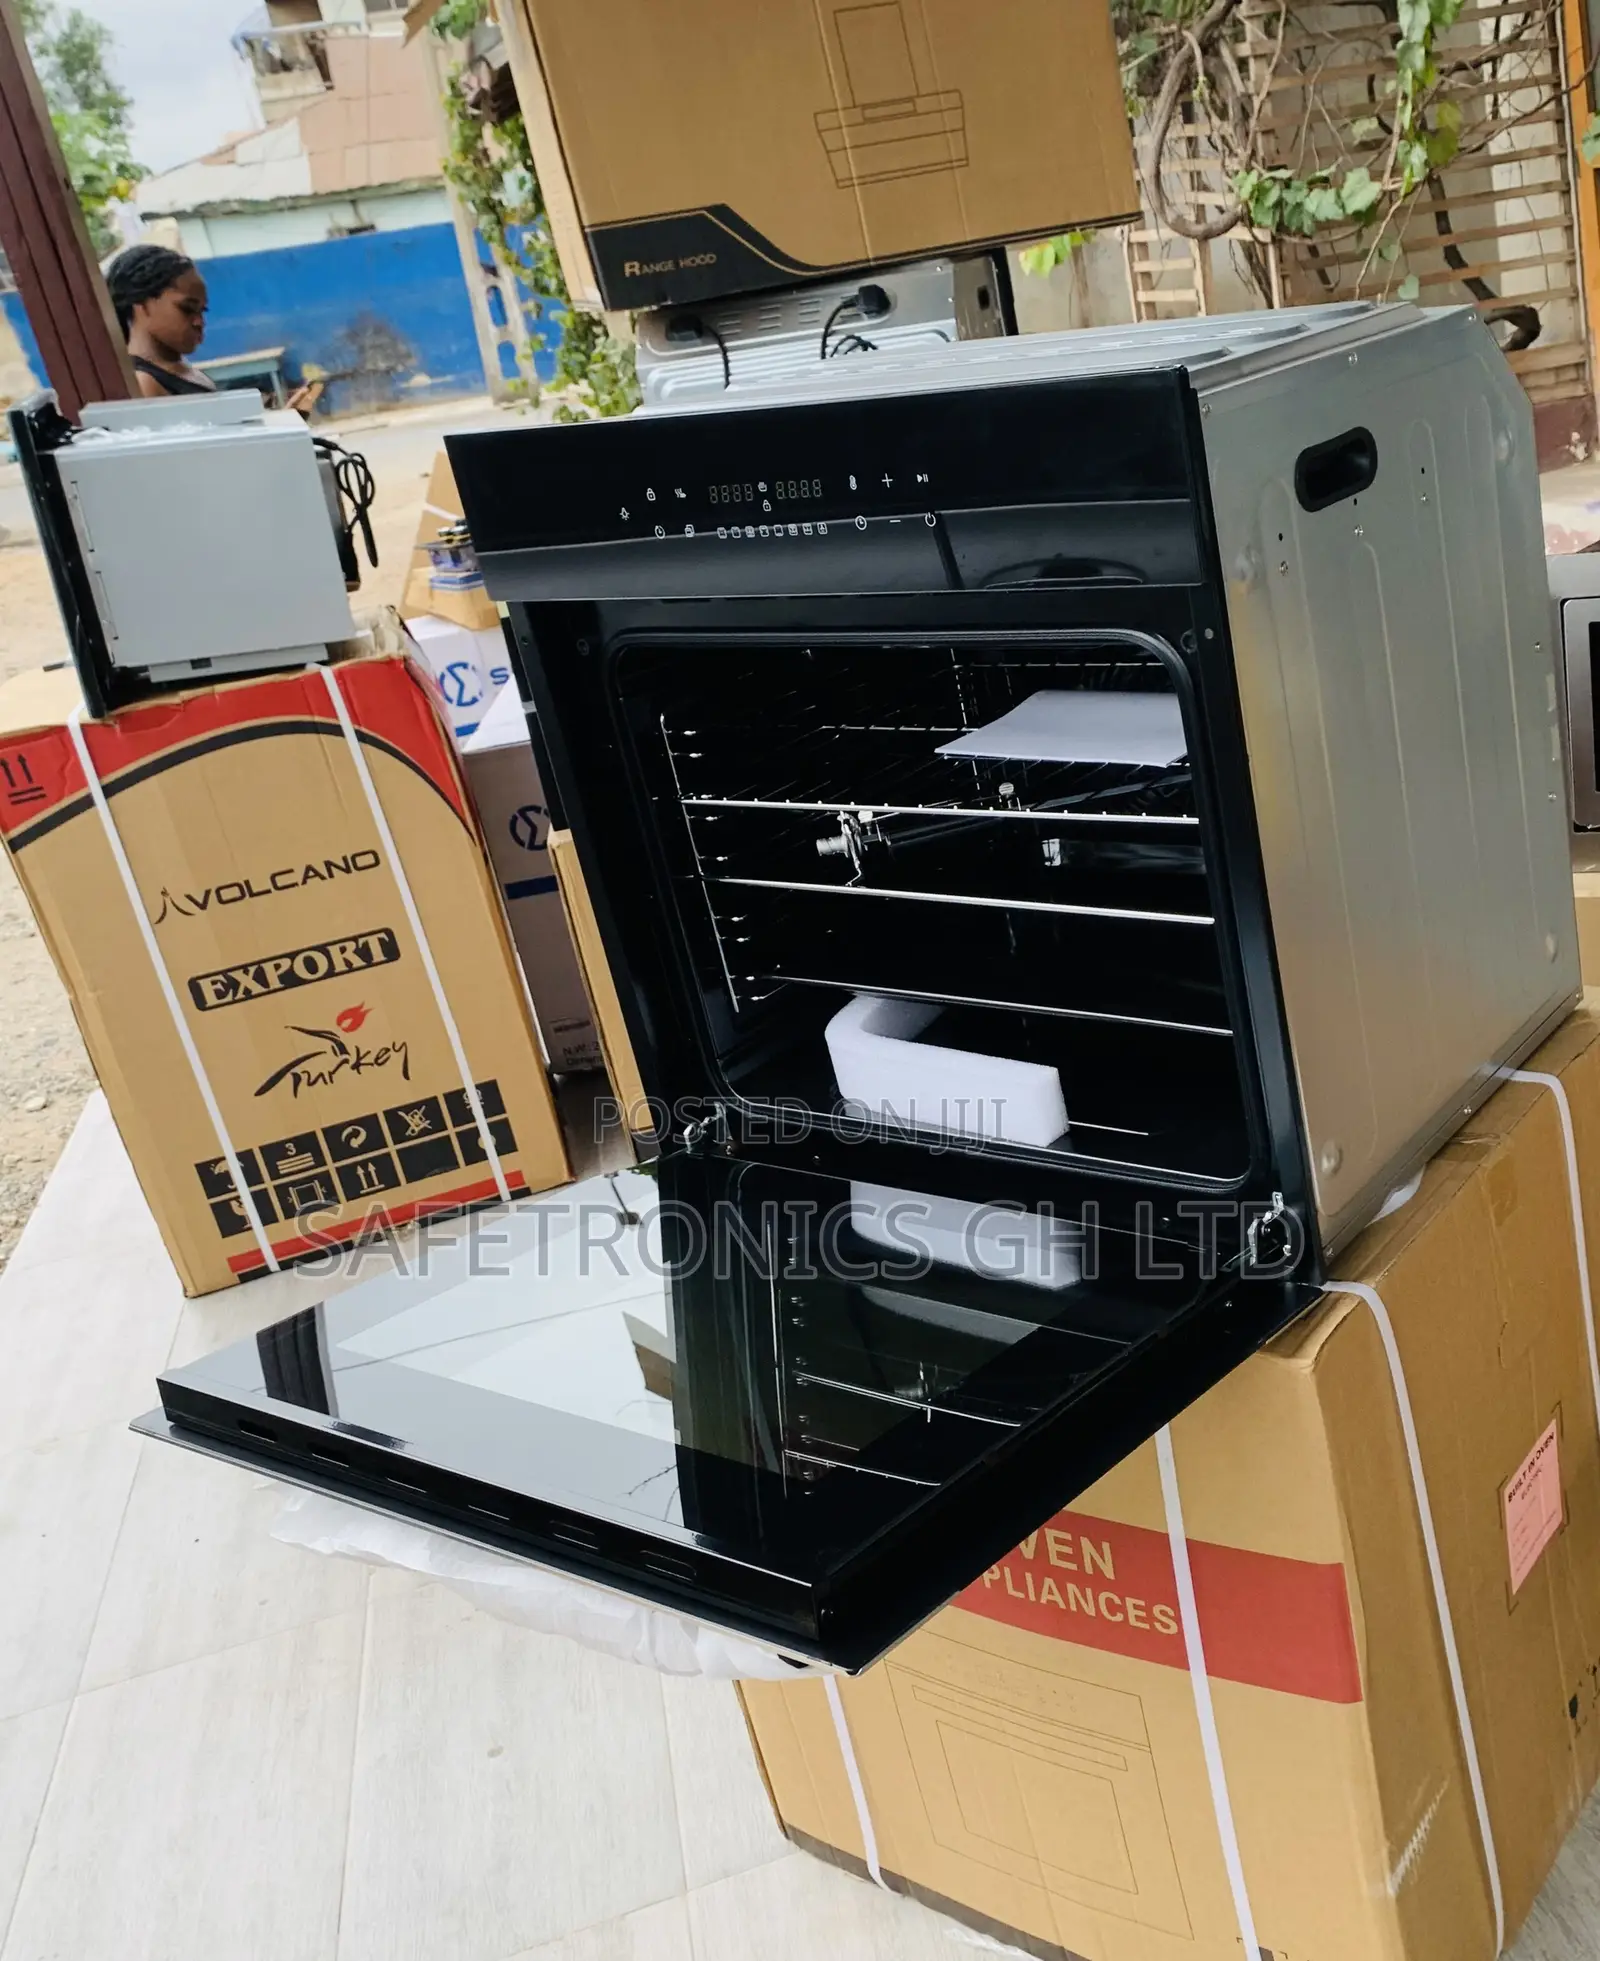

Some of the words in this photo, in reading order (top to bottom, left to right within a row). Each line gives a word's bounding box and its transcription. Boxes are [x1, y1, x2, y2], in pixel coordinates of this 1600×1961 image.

[624, 259, 676, 278] RANGE
[679, 253, 717, 269] HOOD
[184, 849, 381, 911] VOLCANO
[196, 932, 390, 1008] EXPORT
[1508, 1470, 1527, 1503] BUILT
[1536, 1432, 1554, 1460] OVEN
[1018, 1527, 1116, 1580] VEN
[981, 1564, 1179, 1636] PLIANCES
